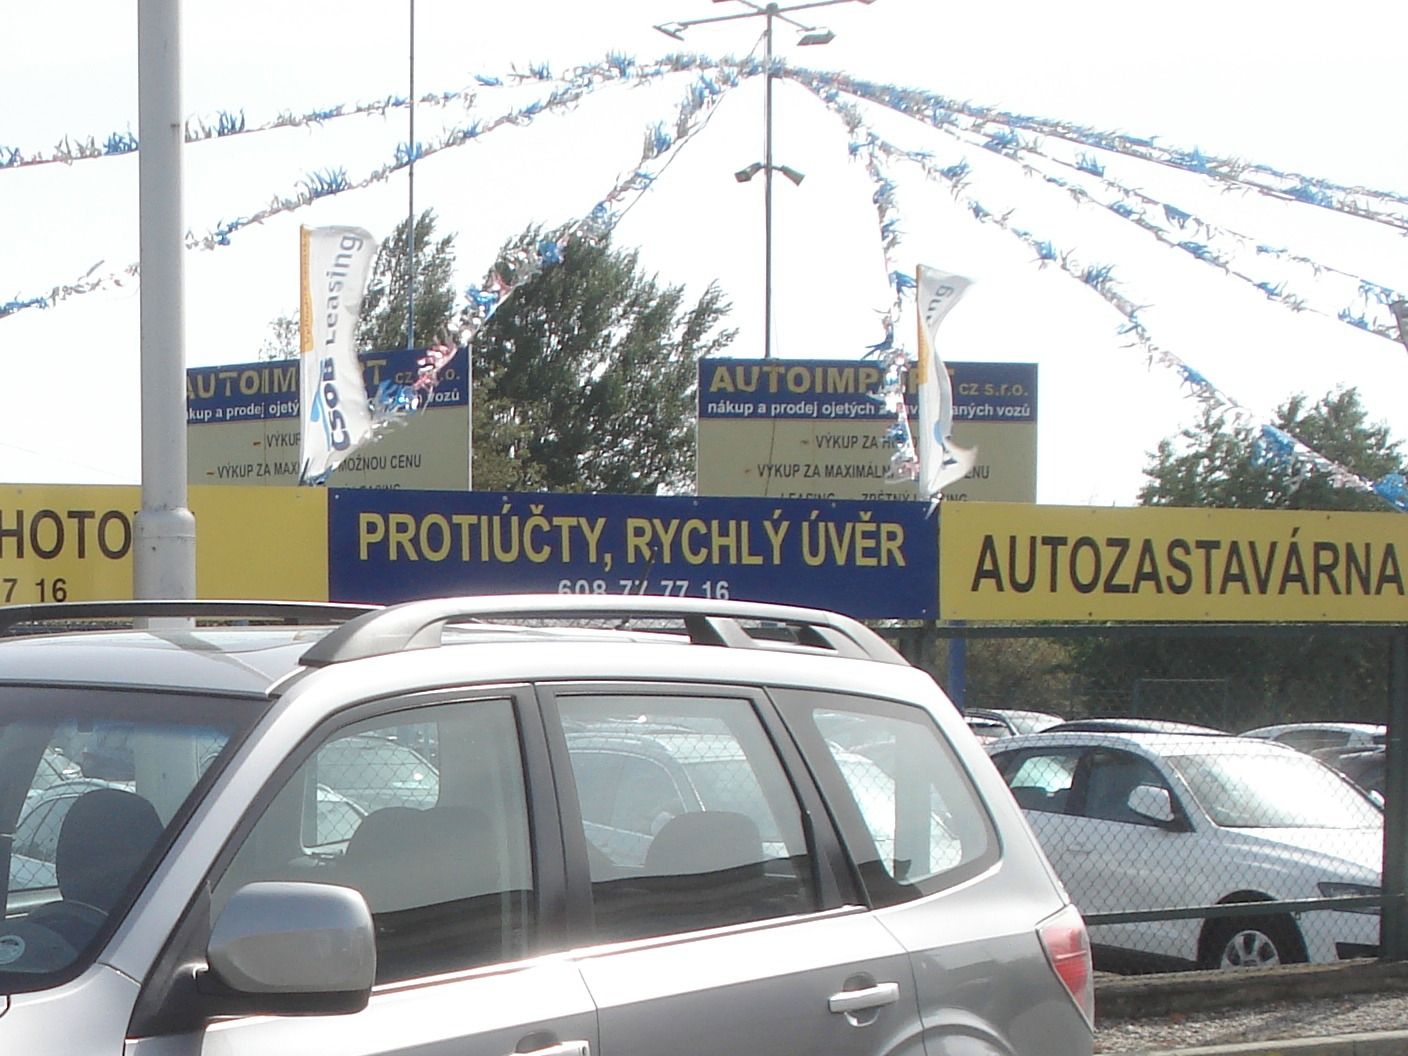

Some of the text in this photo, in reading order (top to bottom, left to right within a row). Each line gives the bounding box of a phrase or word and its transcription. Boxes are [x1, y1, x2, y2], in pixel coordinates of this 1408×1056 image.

[325, 235, 364, 347] Leasing
[959, 383, 979, 396] cz
[985, 383, 1029, 397] s.r.o.
[187, 407, 212, 422] kup
[215, 408, 223, 418] a
[226, 402, 265, 420] prodej
[268, 399, 300, 417] ojetý
[707, 399, 754, 417] nákup
[757, 402, 767, 414] a
[771, 401, 818, 417] prodej
[822, 400, 875, 418] ojetých
[862, 435, 879, 449] ZA
[256, 463, 271, 477] ZA
[391, 453, 422, 470] CENU
[803, 464, 821, 479] ZA
[824, 461, 893, 479] MAXIMÁLN
[358, 503, 907, 573] PROTIÚČTY, RYCHLÝ ÚVĚR
[970, 526, 1406, 596] AUTOZASTAVÁRNA
[34, 577, 68, 603] 16
[558, 579, 608, 595] 608
[660, 579, 690, 597] 77
[701, 580, 730, 600] 16
